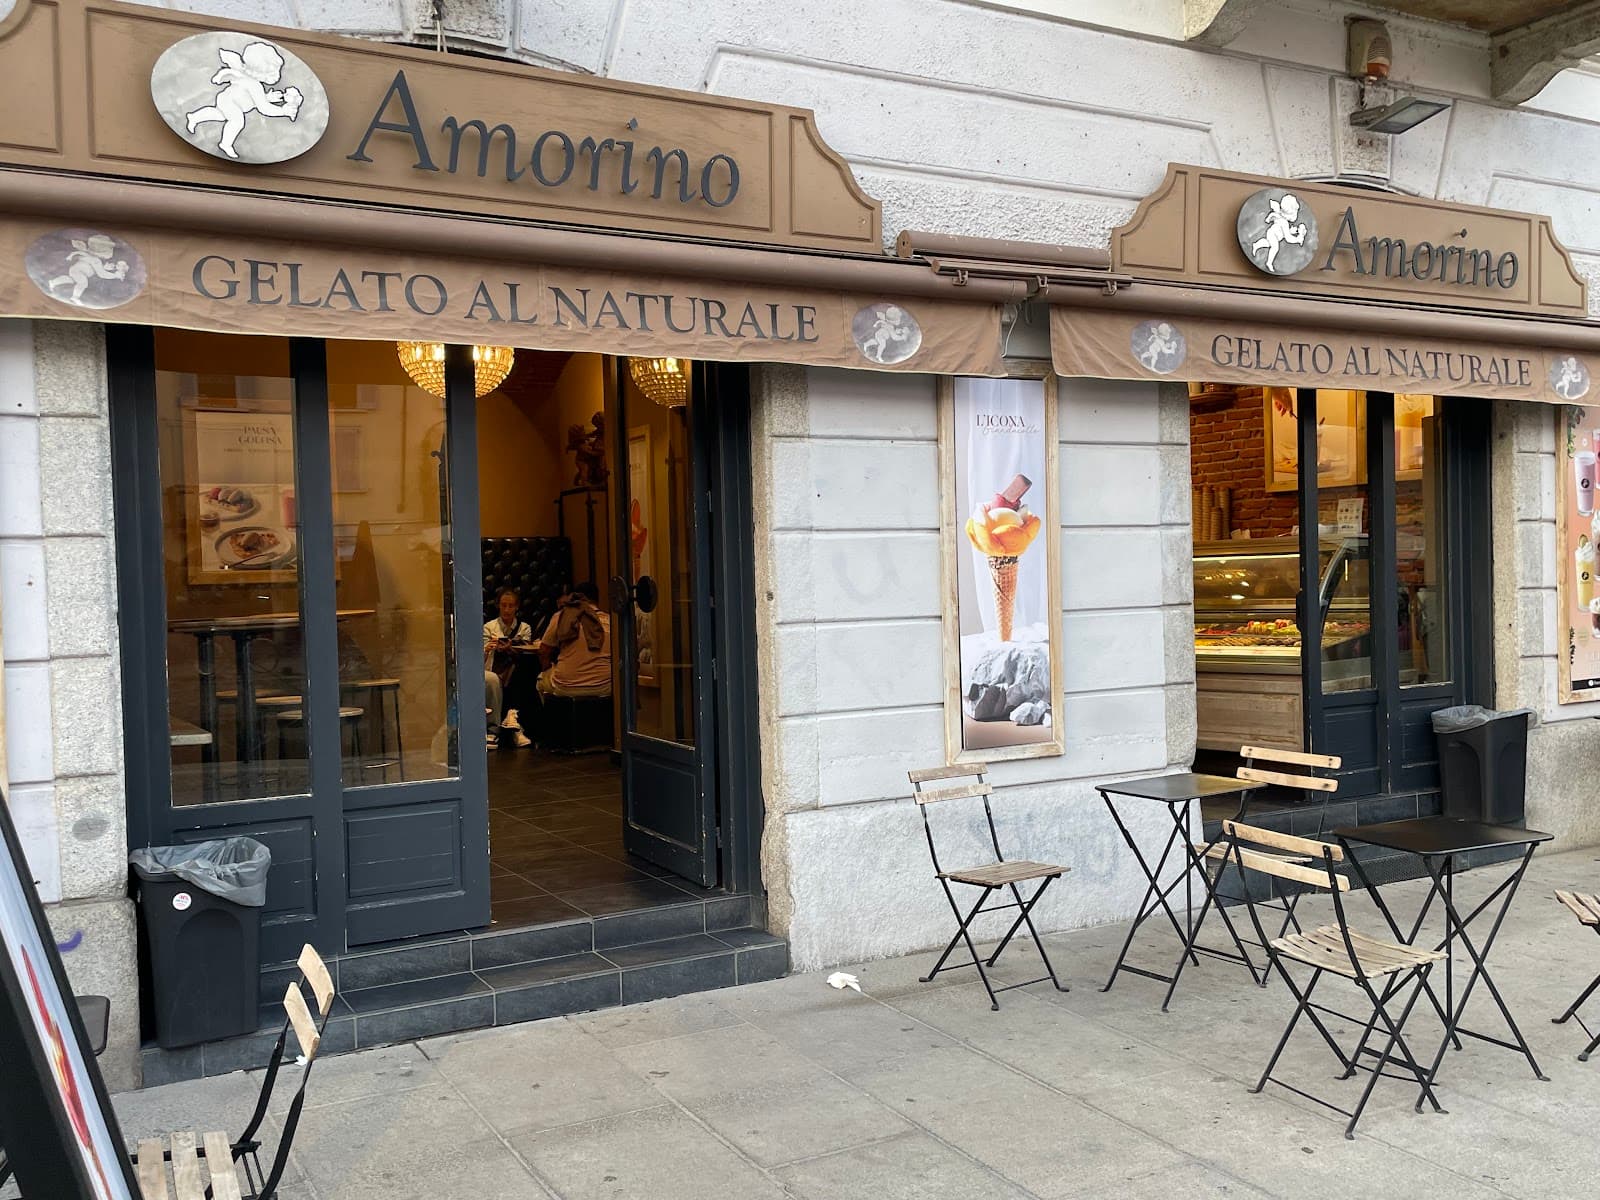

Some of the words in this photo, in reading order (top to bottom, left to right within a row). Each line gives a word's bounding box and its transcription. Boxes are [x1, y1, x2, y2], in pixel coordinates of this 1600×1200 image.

[346, 69, 741, 208] Amorino
[1319, 206, 1519, 288] Amorino
[192, 255, 448, 315] GELATO
[464, 280, 537, 324] AL
[548, 286, 820, 342] NATURALE
[1211, 334, 1333, 374] GELATO
[1342, 346, 1381, 376] AL
[1386, 348, 1532, 386] NATURALE
